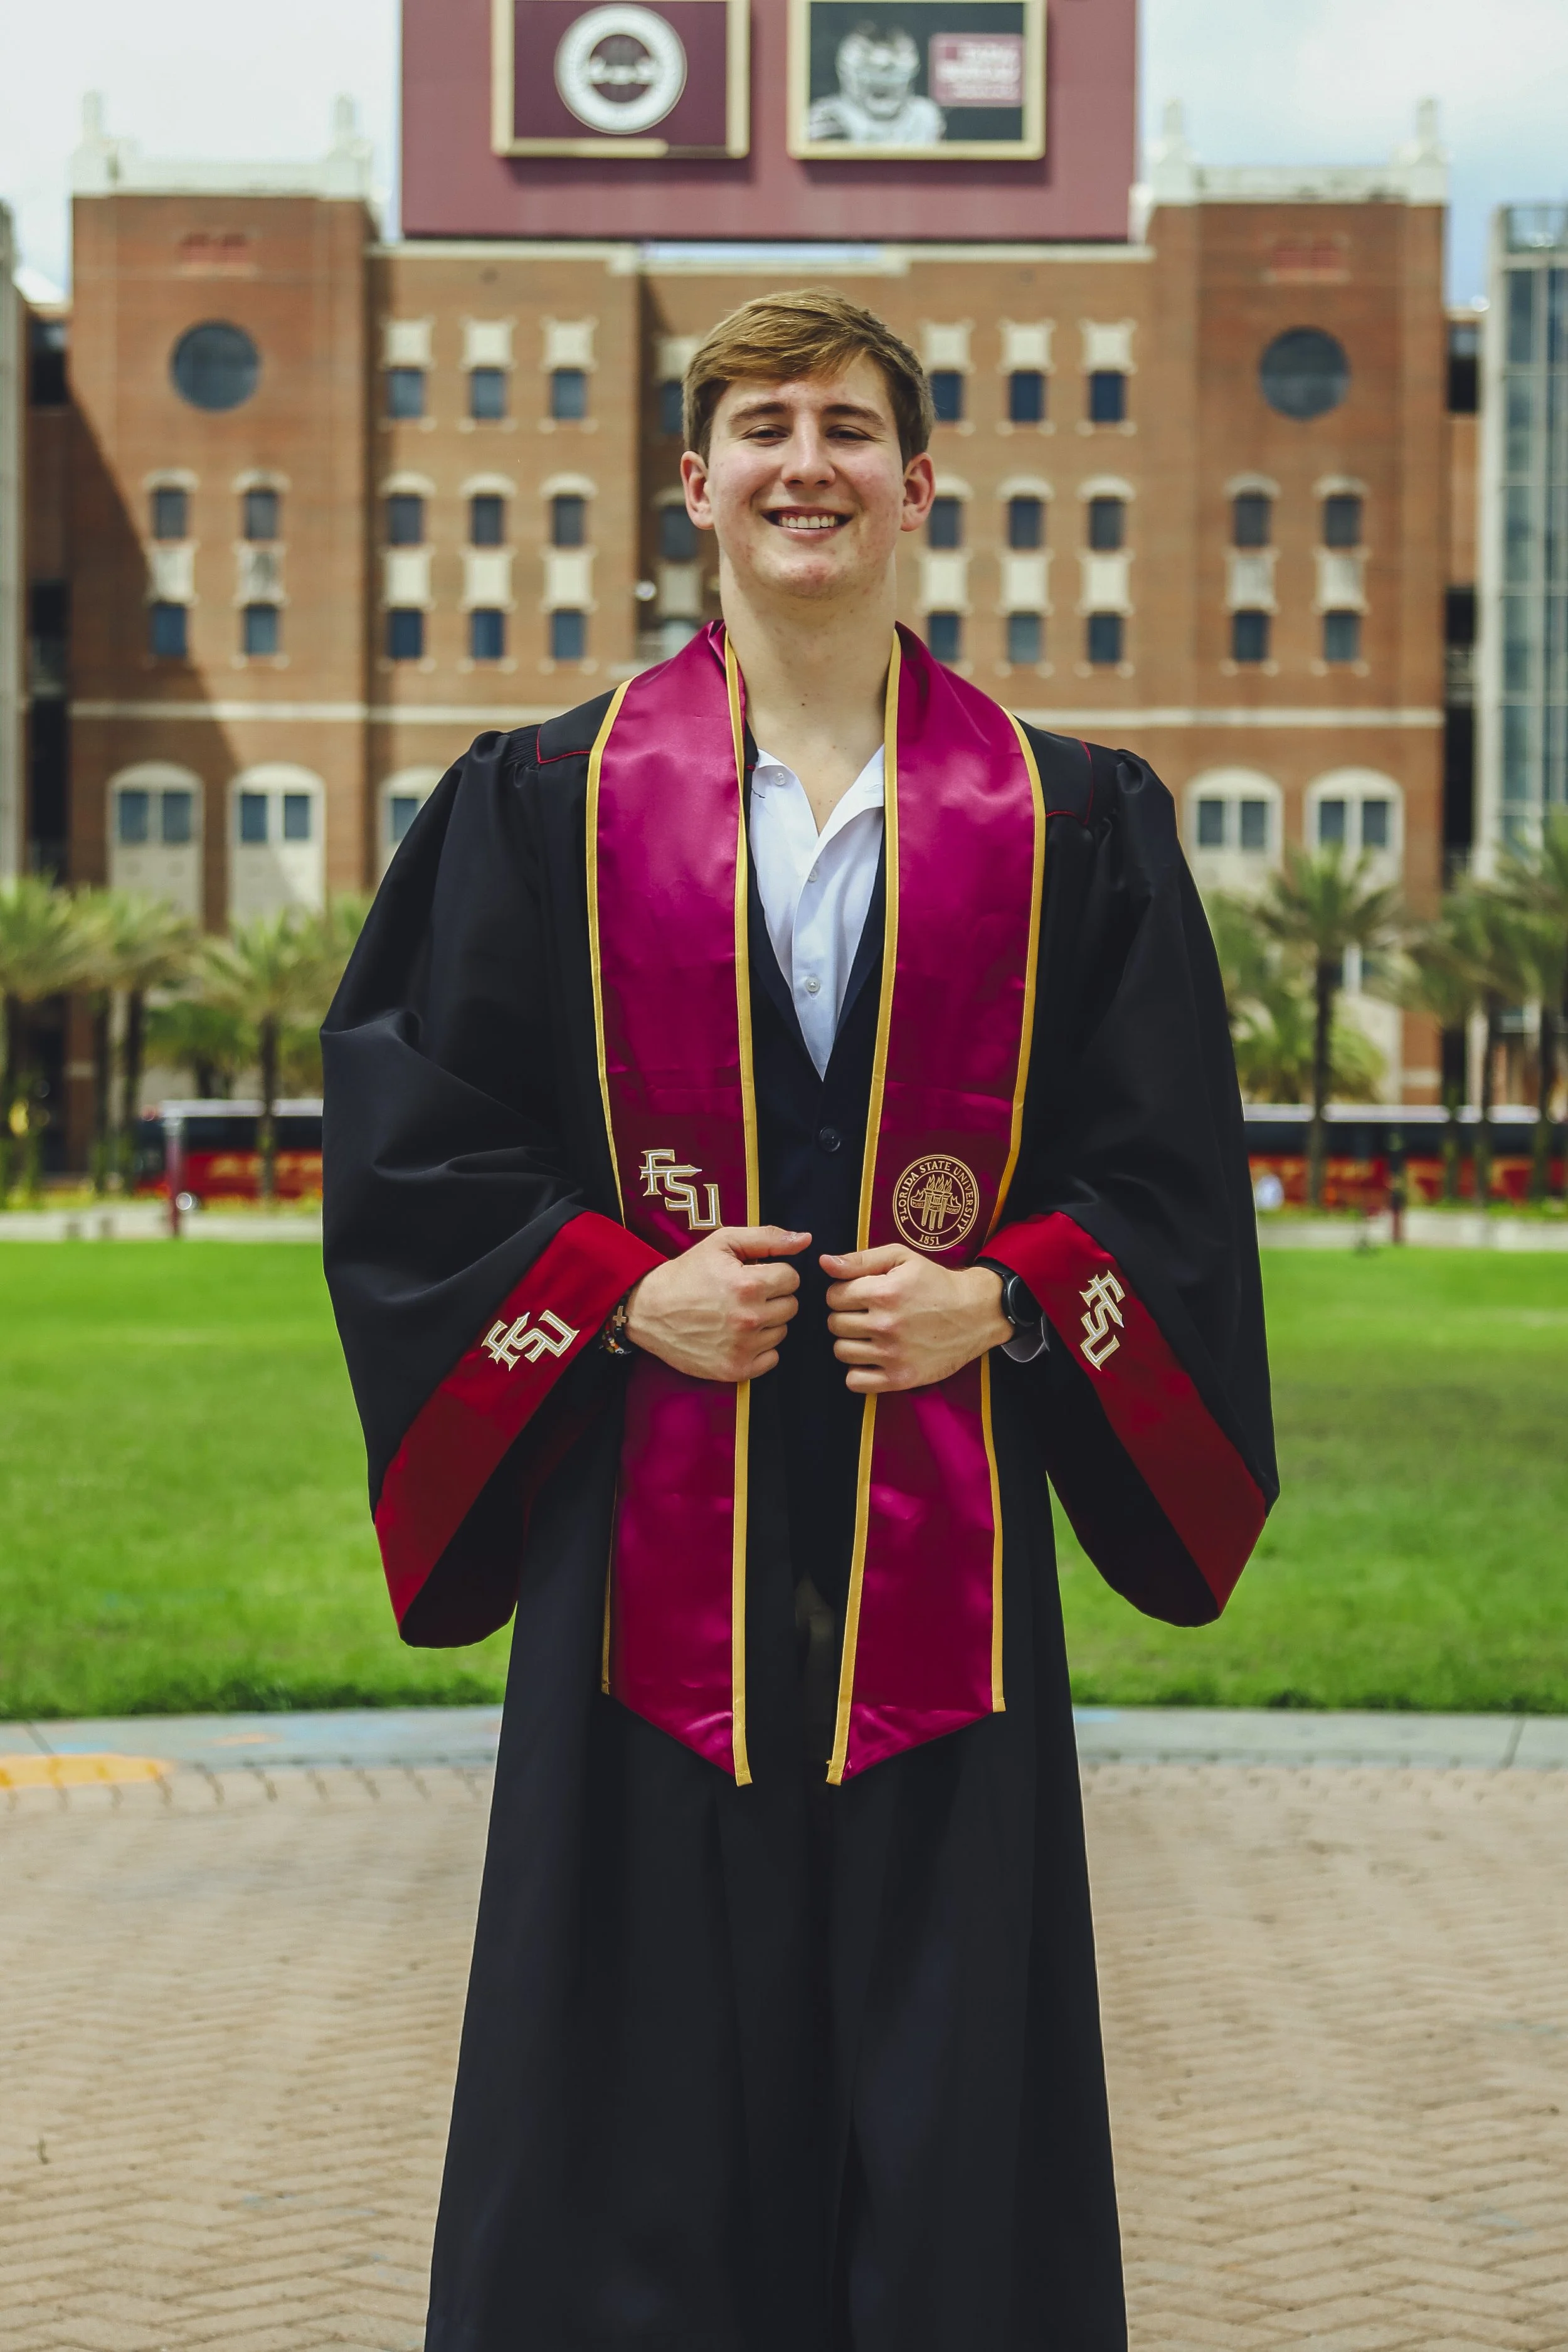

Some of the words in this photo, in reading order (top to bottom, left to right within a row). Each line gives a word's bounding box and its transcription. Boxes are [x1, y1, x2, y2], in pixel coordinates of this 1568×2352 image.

[638, 1149, 723, 1230] FSU
[899, 1172, 919, 1222] FLORIDA
[919, 1161, 951, 1173] STATE
[953, 1167, 974, 1232] UNIVERSITY
[919, 1234, 940, 1245] 1851
[481, 1309, 580, 1372] FSU
[1079, 1269, 1125, 1371] FSU
